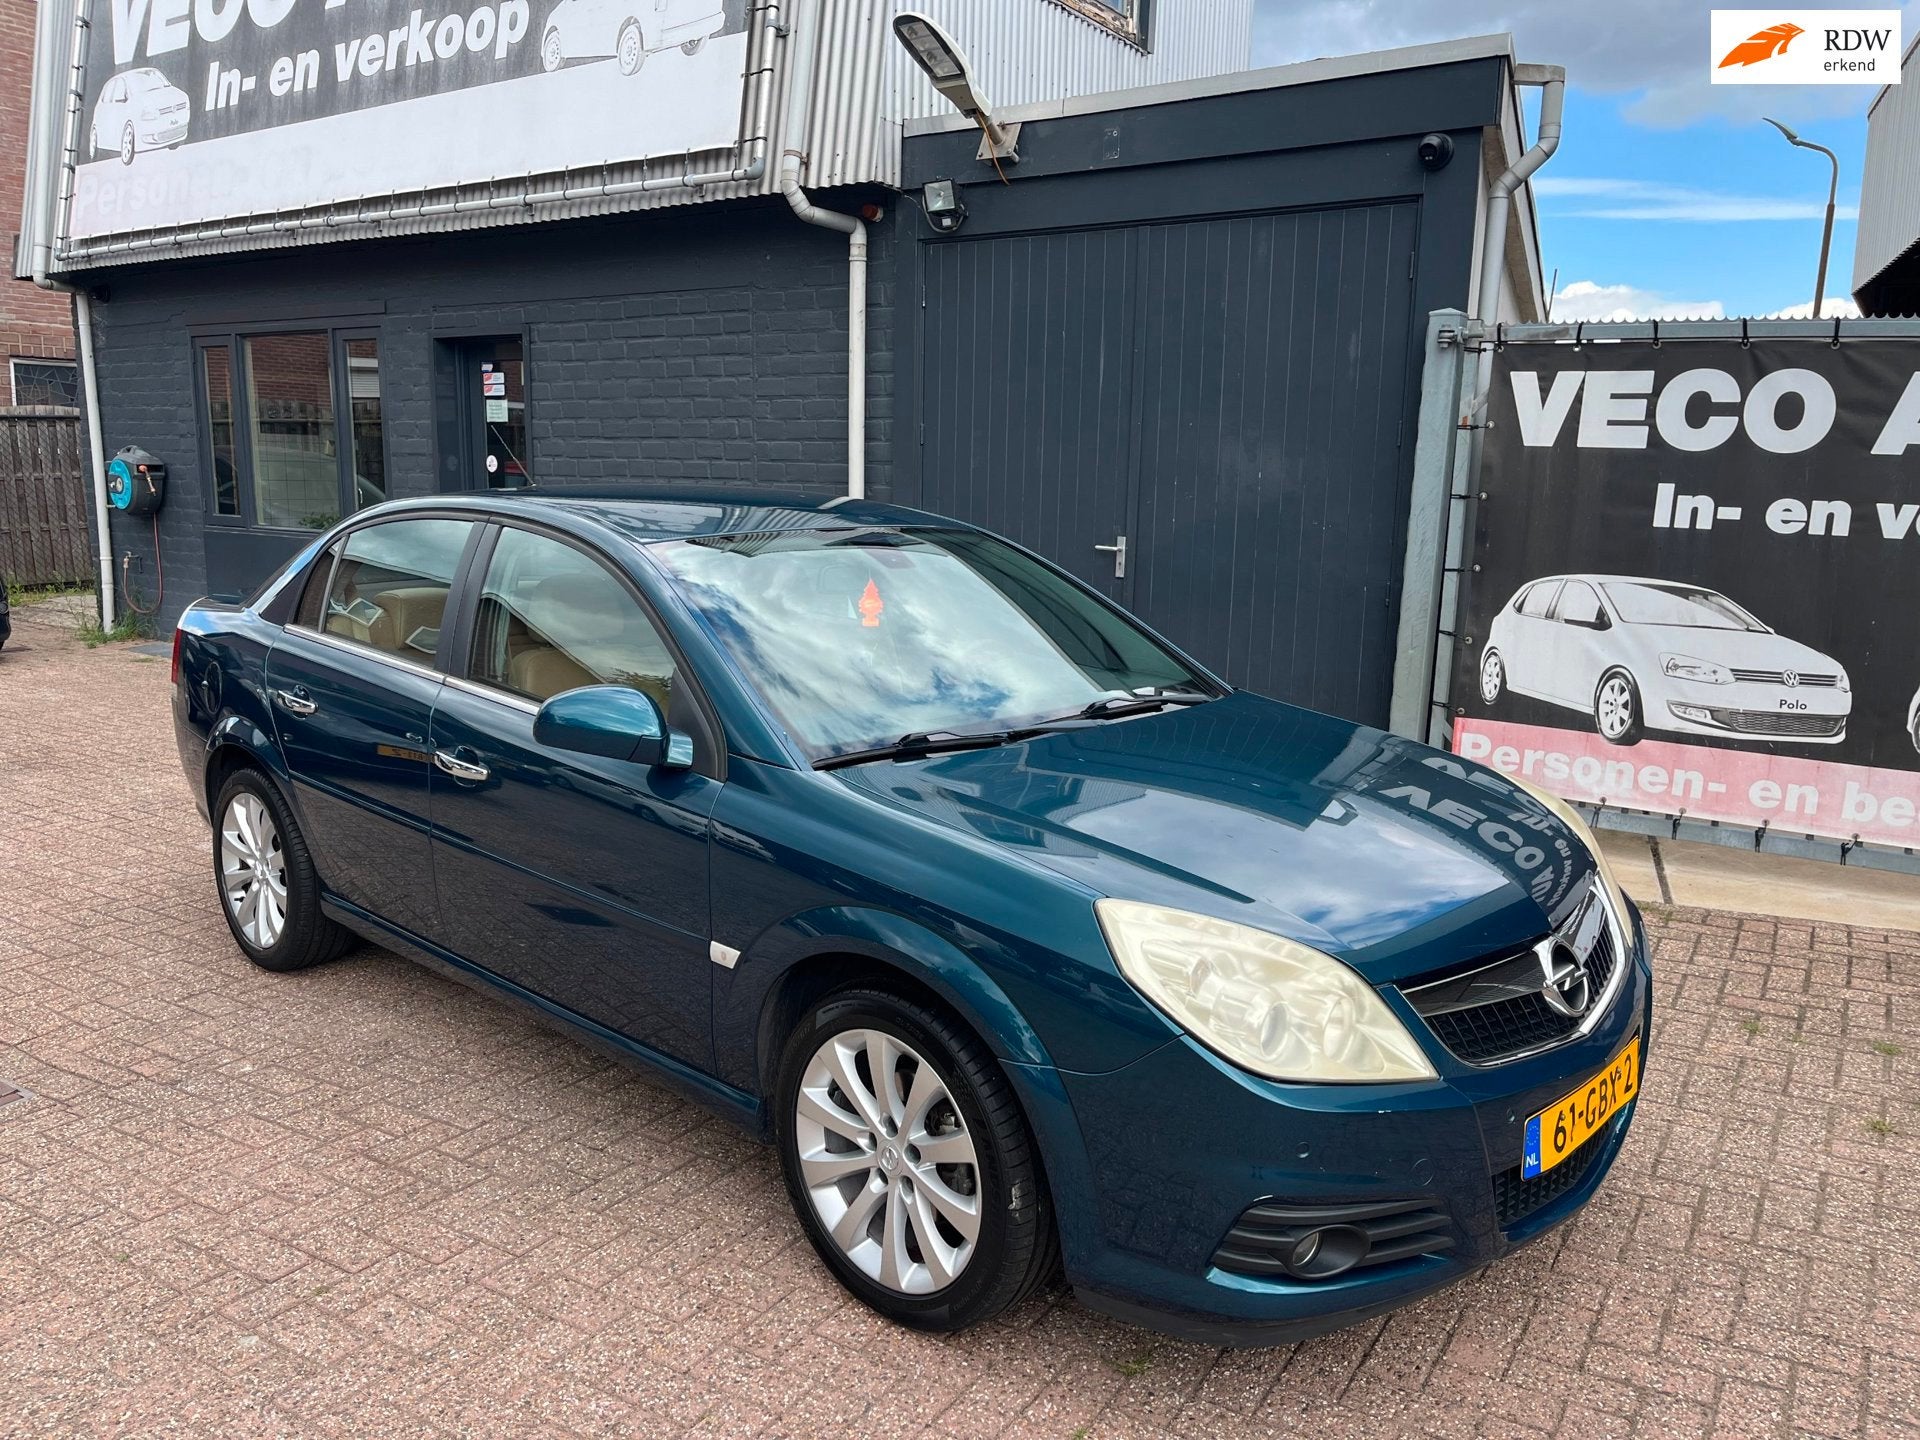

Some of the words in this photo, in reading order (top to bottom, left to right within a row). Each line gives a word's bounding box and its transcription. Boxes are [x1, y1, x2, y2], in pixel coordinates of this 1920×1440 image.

[112, 0, 297, 65] VE
[205, 61, 257, 111] In-
[269, 49, 320, 97] en
[335, 0, 530, 82] verkoop
[1509, 368, 1836, 453] VECO
[1652, 483, 1742, 530] In-
[1765, 498, 1852, 537] en
[1875, 503, 1920, 540] v
[1779, 699, 1807, 710] Polo
[1460, 732, 1727, 801] Personen-
[1748, 779, 1820, 816] en
[1841, 780, 1920, 828] be
[1553, 1053, 1633, 1154] 61-GBX-2
[1525, 1152, 1539, 1168] NL
